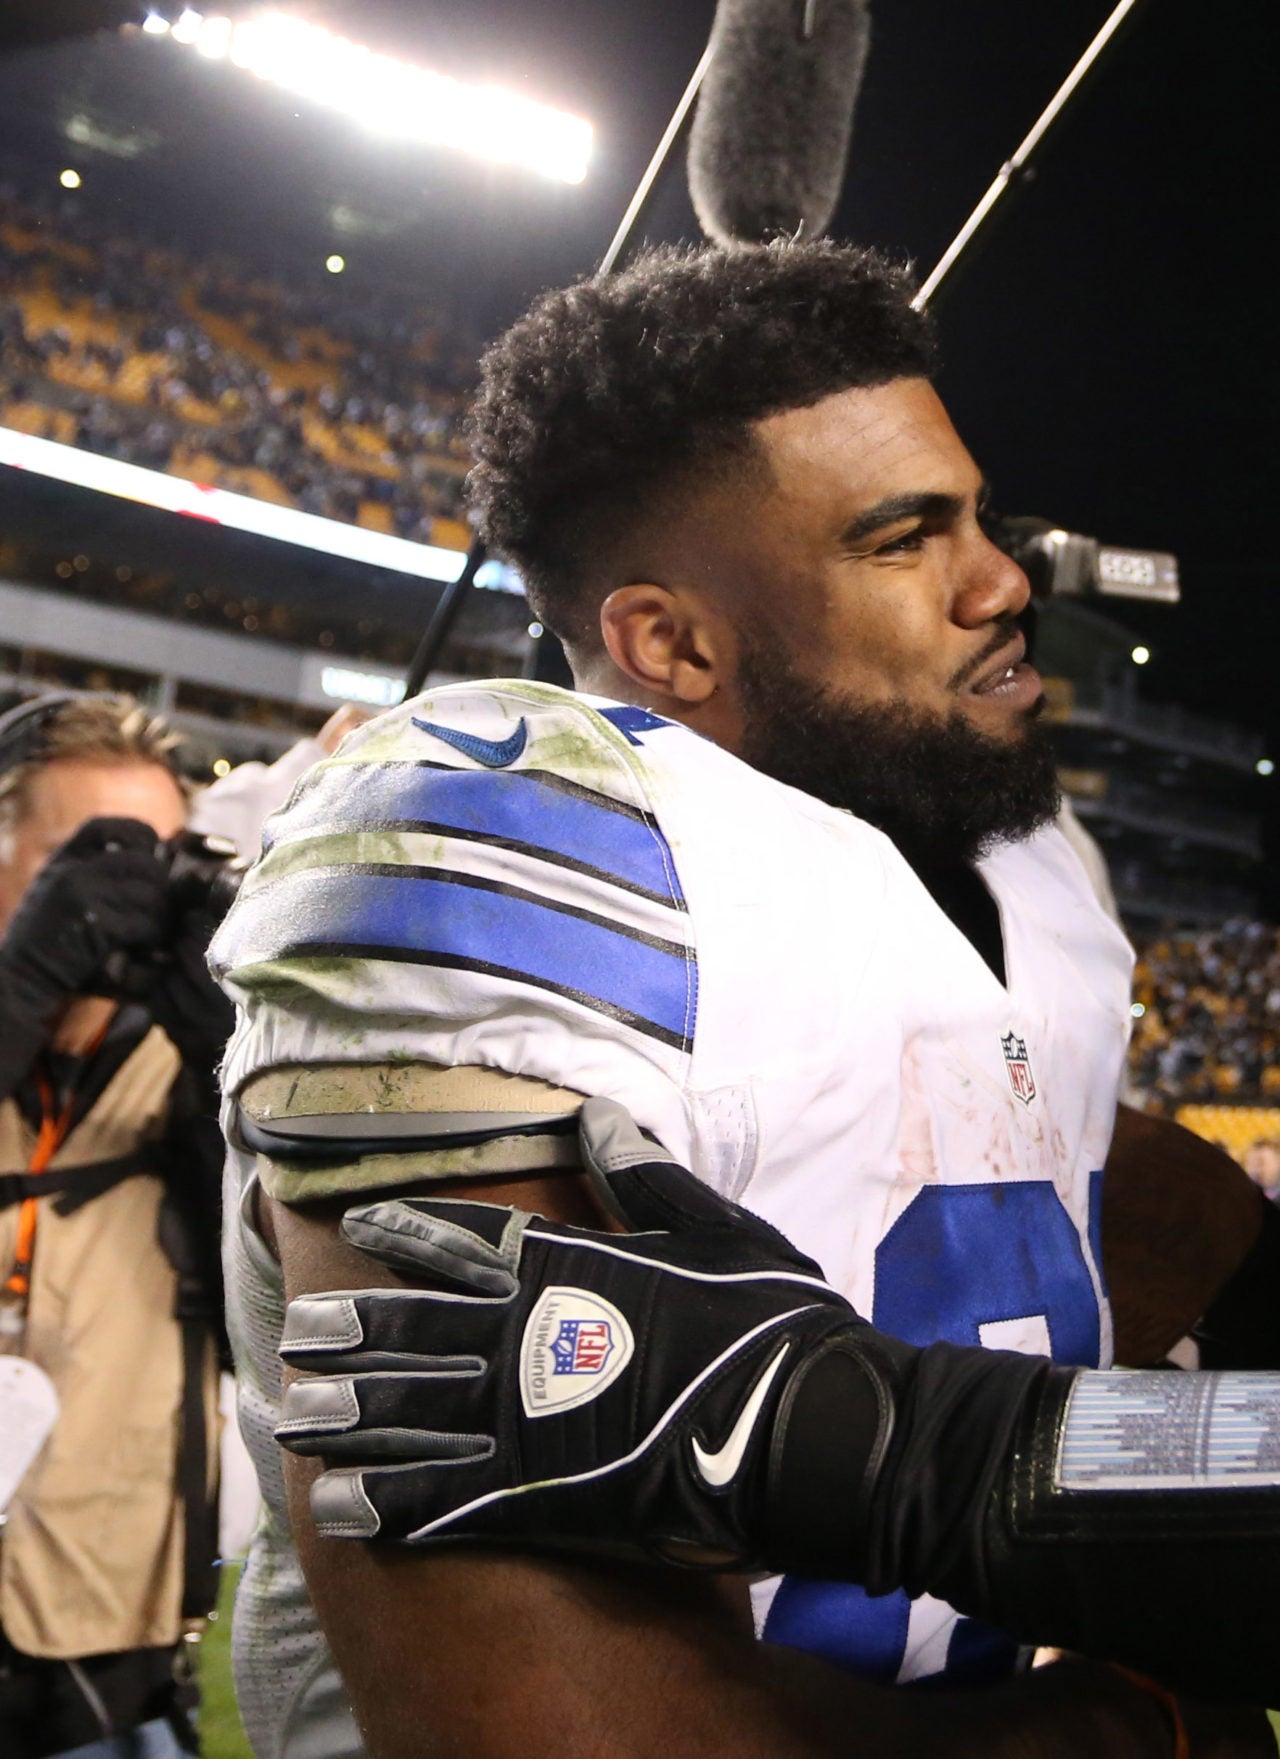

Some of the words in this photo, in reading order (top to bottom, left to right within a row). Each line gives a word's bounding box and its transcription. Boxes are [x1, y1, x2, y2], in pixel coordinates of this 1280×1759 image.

[1008, 1062, 1034, 1097] NFL
[532, 1302, 560, 1400] EQUIPMENT
[575, 1325, 608, 1369] NFL
